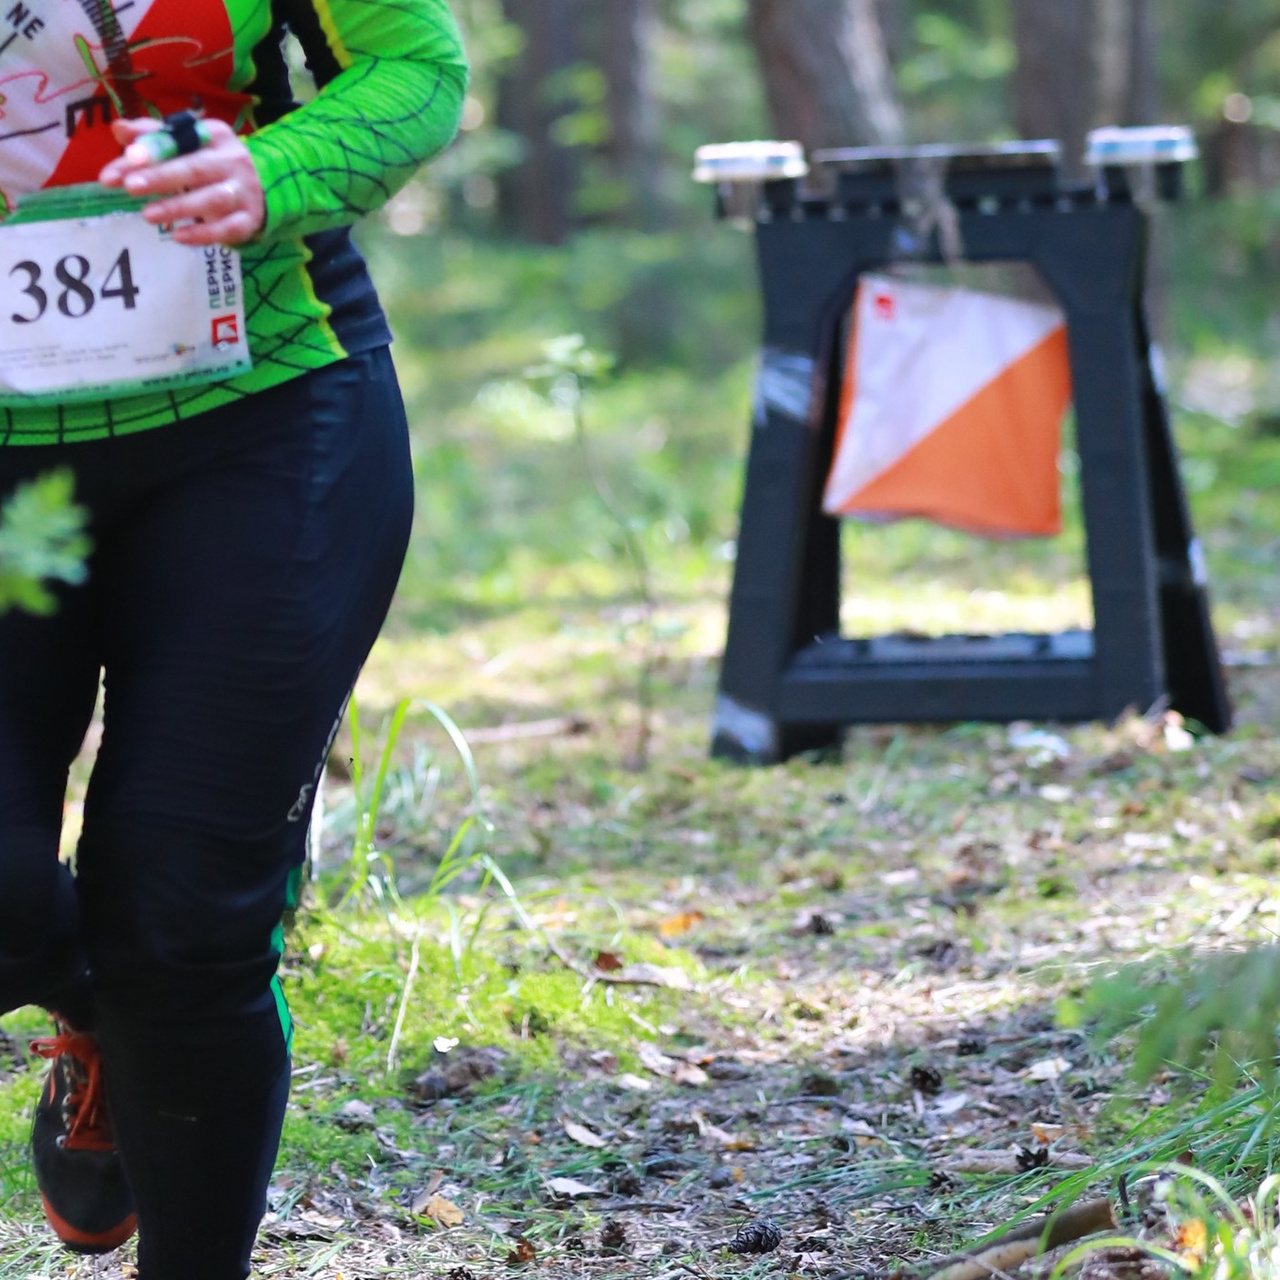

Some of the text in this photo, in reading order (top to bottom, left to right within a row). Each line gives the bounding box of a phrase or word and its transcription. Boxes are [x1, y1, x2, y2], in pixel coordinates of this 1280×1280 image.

[4, 0, 46, 41] NE
[65, 96, 112, 138] E
[7, 246, 141, 325] 384
